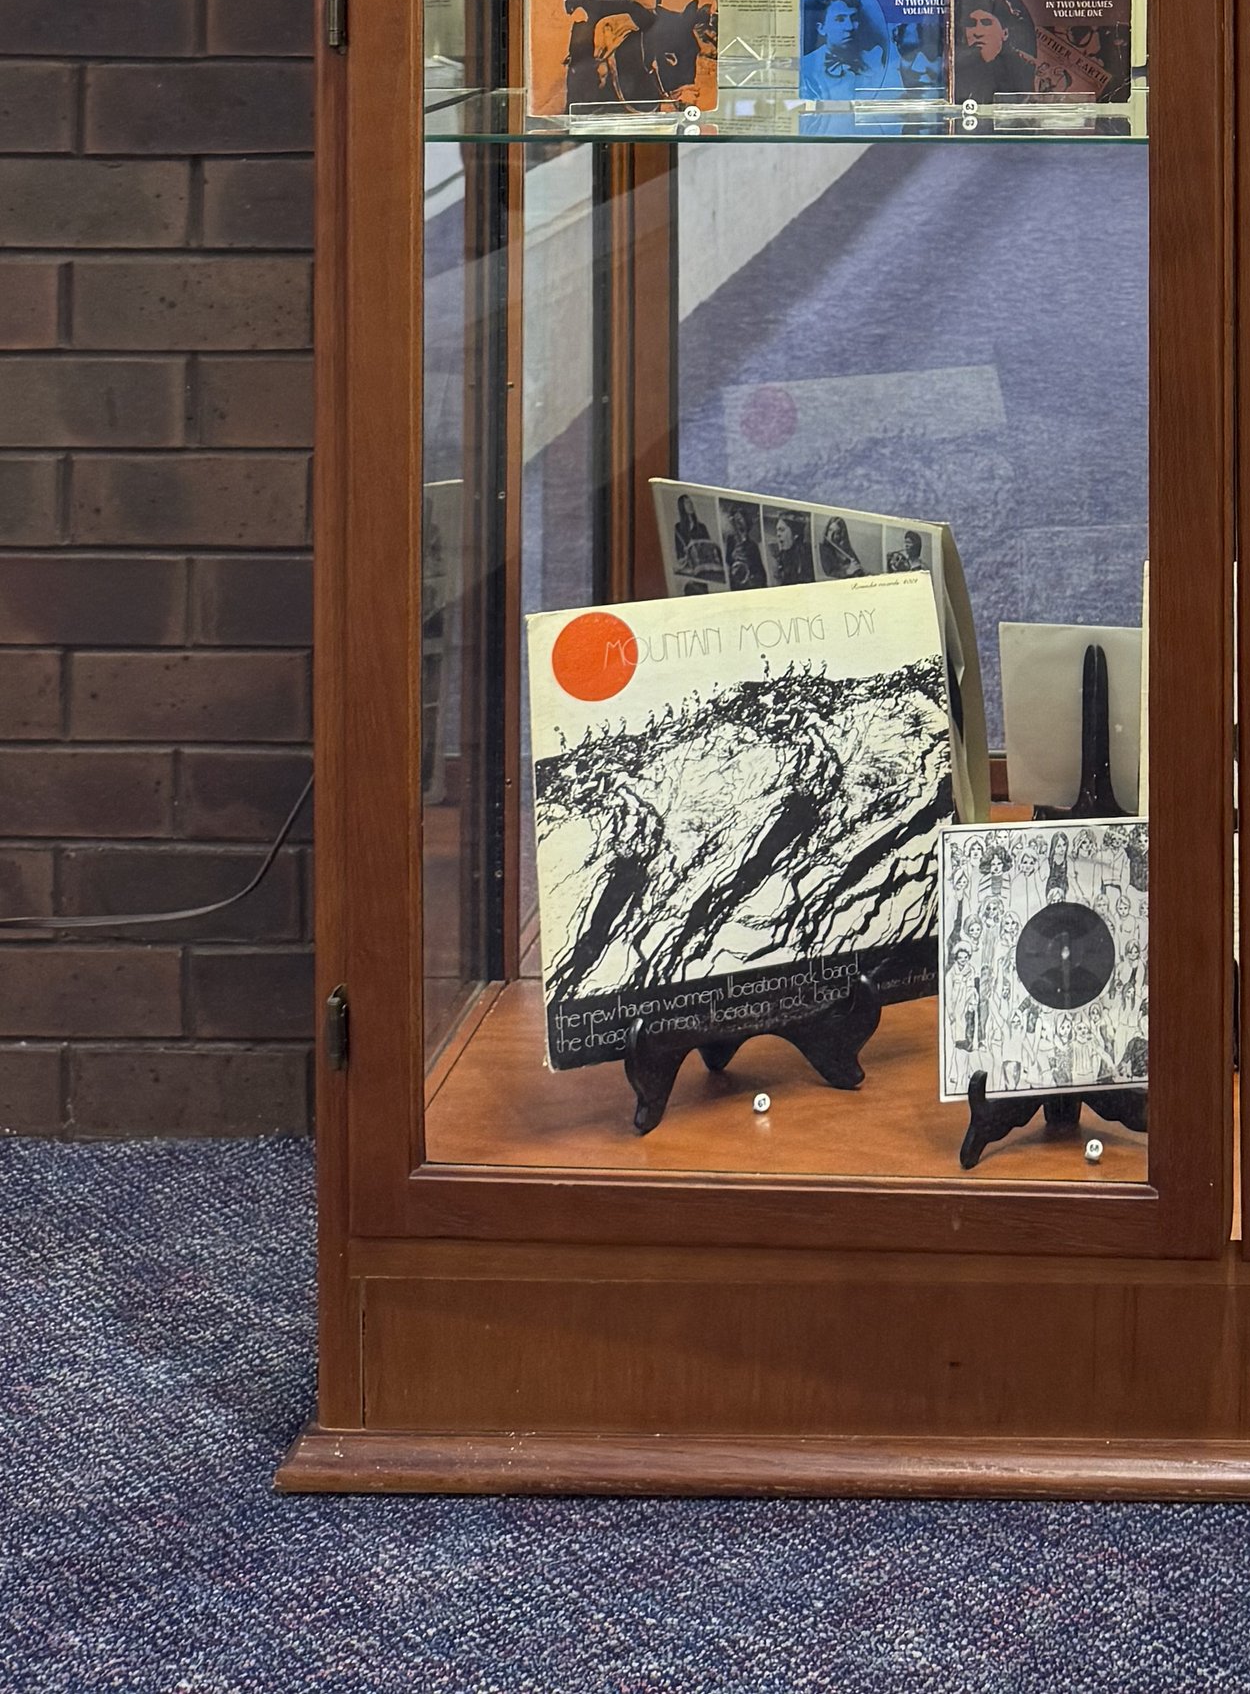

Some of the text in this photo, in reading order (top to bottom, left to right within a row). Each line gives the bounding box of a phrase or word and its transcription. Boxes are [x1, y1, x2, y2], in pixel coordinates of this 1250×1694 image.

[1053, 9, 1103, 18] VOLUME ONE
[1076, 0, 1113, 8] VOLUMES
[1036, 28, 1108, 84] MOTHER EARTH
[603, 608, 876, 670] MOUNTAIN MOVING DAY
[556, 1004, 580, 1030] the
[583, 1009, 616, 1025] new
[617, 995, 660, 1018] haven
[728, 975, 788, 998] liberation
[790, 960, 819, 988] rock
